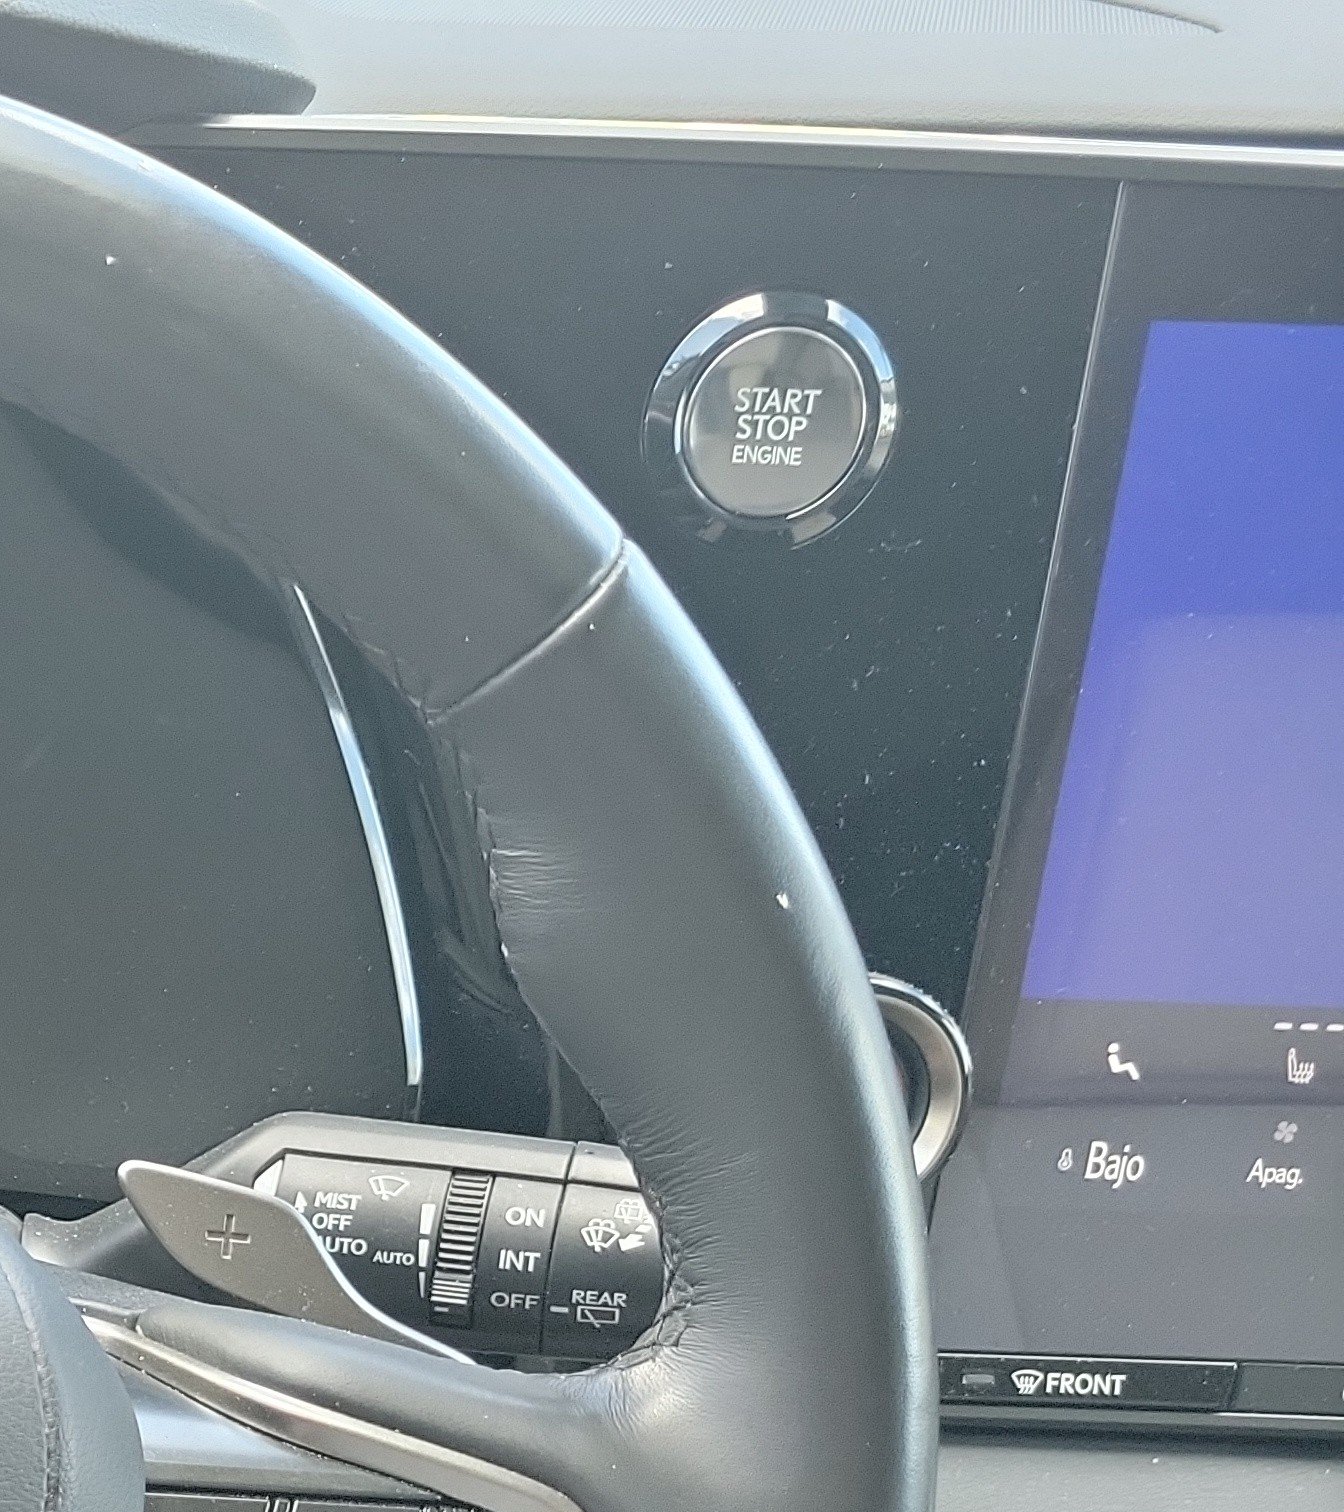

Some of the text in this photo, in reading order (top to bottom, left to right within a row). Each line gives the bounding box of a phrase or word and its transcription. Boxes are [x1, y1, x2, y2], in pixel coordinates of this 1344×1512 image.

[733, 386, 822, 415] START
[735, 413, 808, 442] STOP
[731, 444, 802, 467] ENGINE
[1084, 1141, 1146, 1189] Bajo
[1246, 1158, 1304, 1190] Apag.
[314, 1191, 362, 1211] MIST
[312, 1212, 353, 1232] OFF
[505, 1206, 545, 1229] ON
[372, 1250, 415, 1267] AUTO
[498, 1249, 542, 1272] INT
[490, 1291, 540, 1311] OFF
[571, 1289, 627, 1308] REAR
[1045, 1372, 1126, 1396] FRONT
